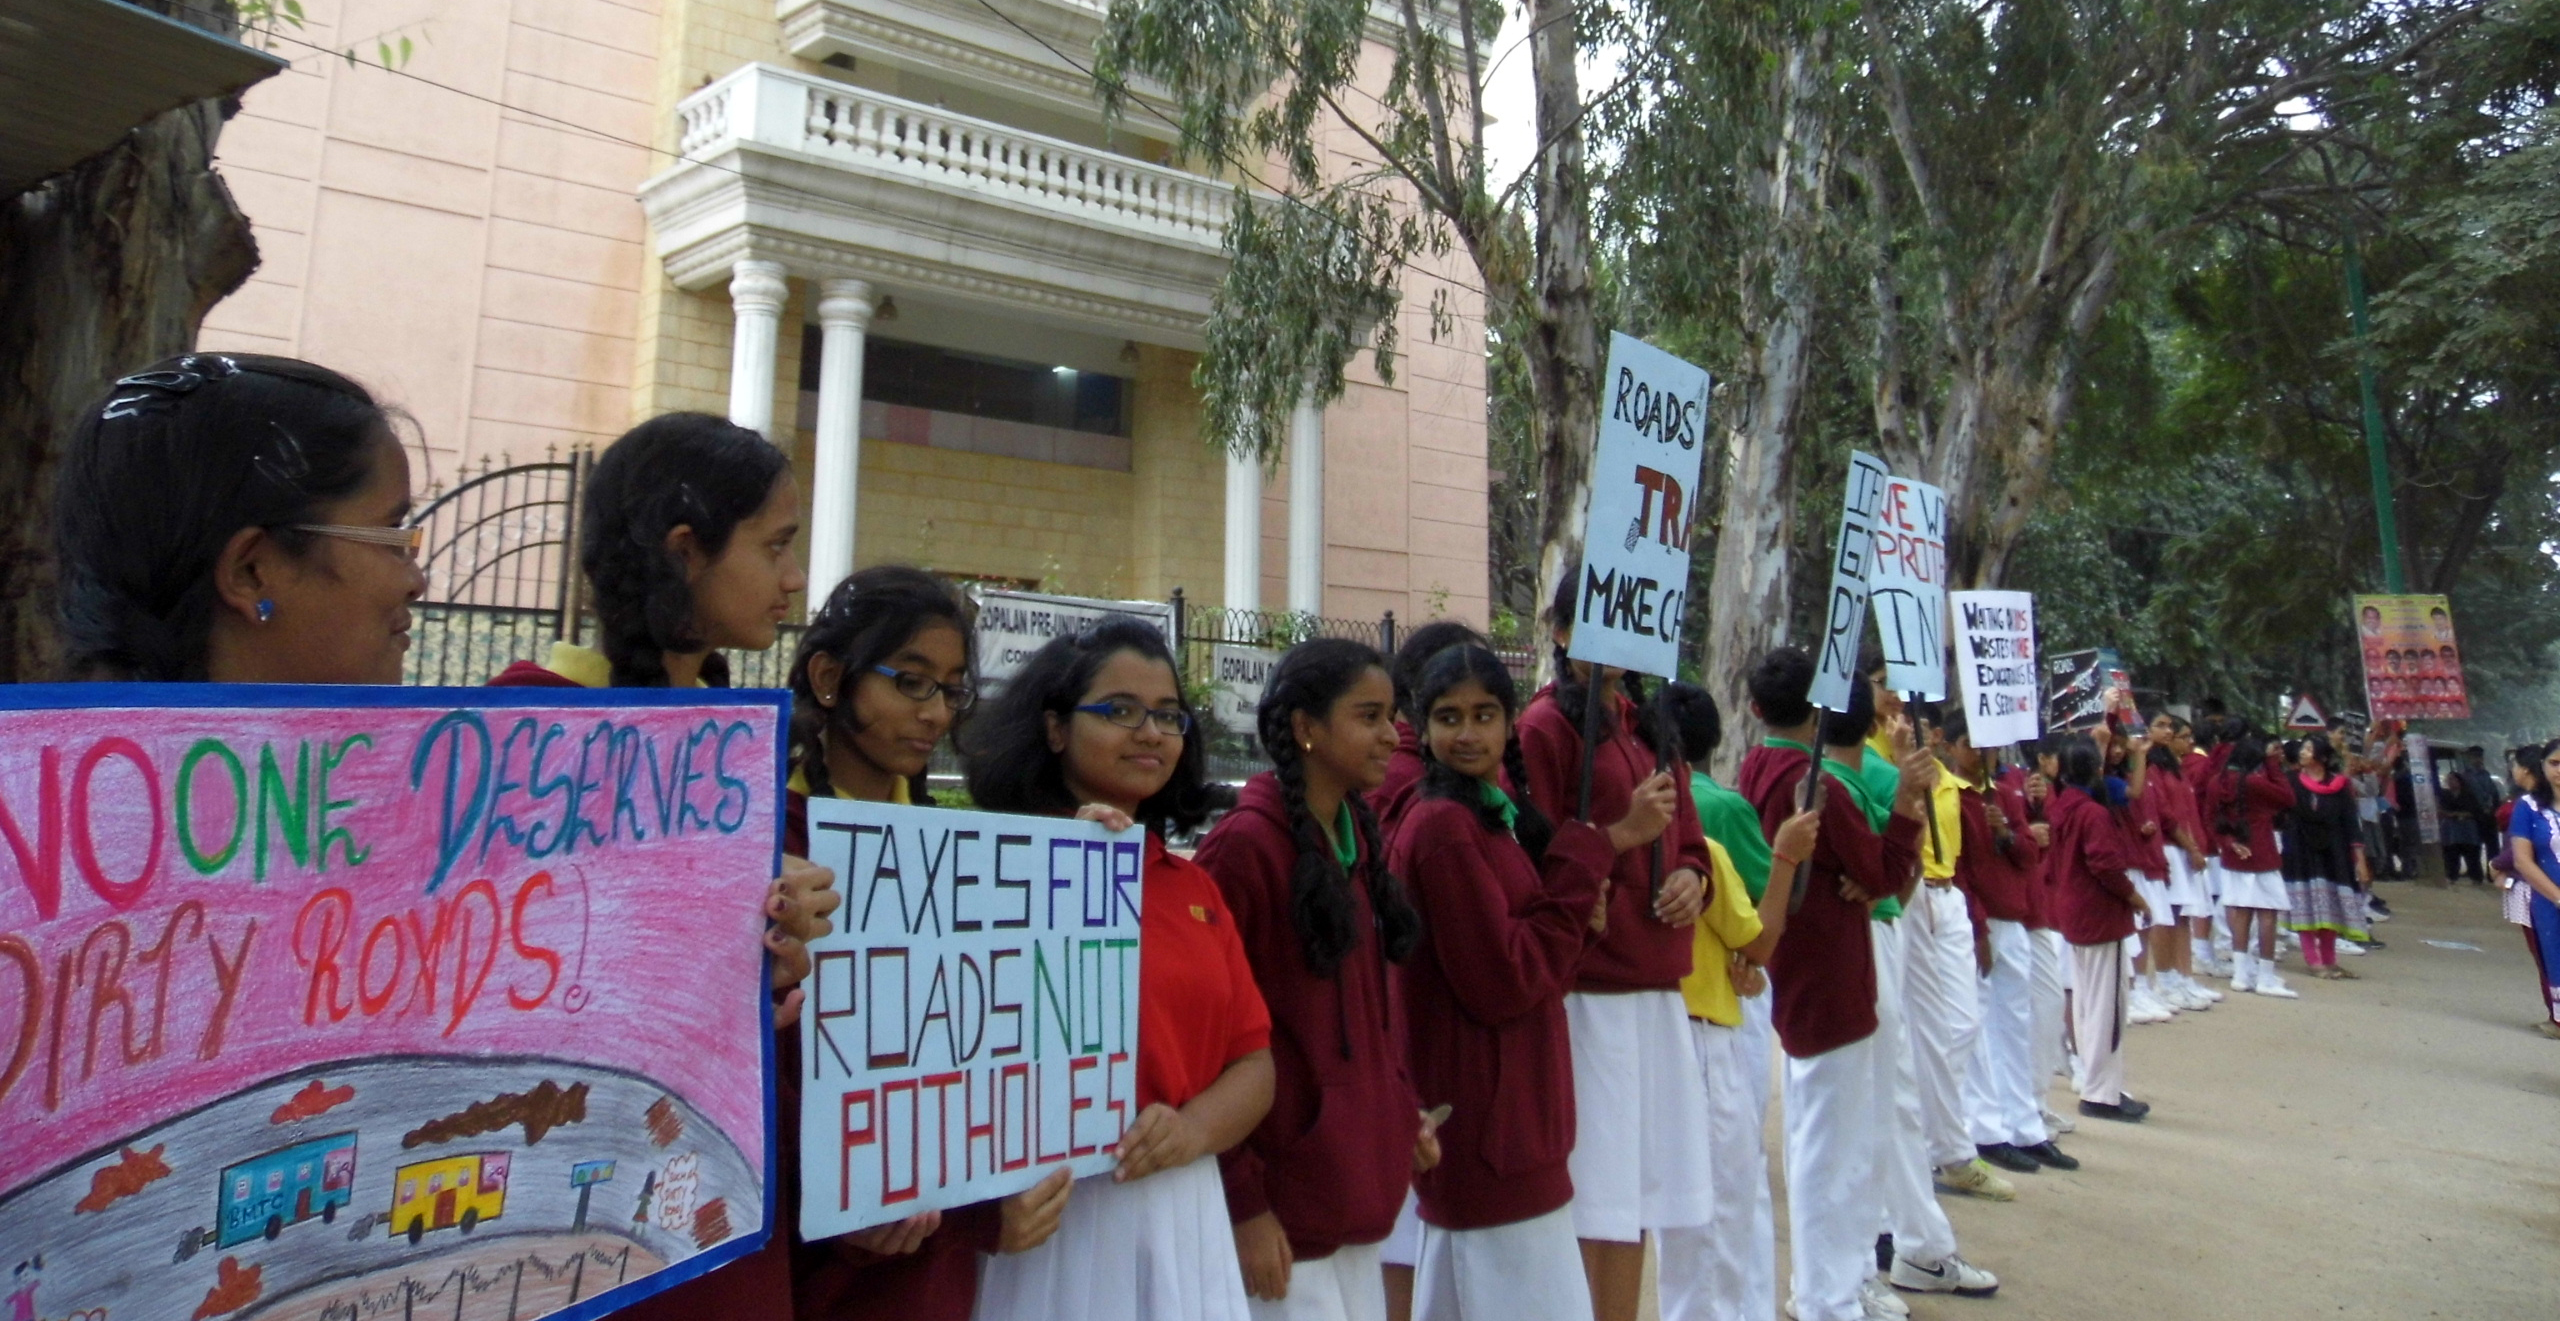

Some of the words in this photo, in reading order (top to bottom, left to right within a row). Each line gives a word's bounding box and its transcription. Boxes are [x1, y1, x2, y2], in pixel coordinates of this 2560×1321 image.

[1613, 366, 1696, 450] ROADS
[1582, 563, 1659, 637] MAKE
[1222, 656, 1265, 685] GOPALAN
[1979, 692, 1991, 716] A
[174, 732, 373, 883] ONE
[410, 709, 754, 894] DESERVES
[816, 820, 1033, 938] TAXES
[1049, 837, 1143, 931] FOR
[0, 900, 257, 1113] DIRTY
[812, 944, 1023, 1081] ROADS
[1033, 936, 1139, 1062] NOT
[839, 1052, 1129, 1212] POTHOLES
[228, 1193, 285, 1230] BMTC
